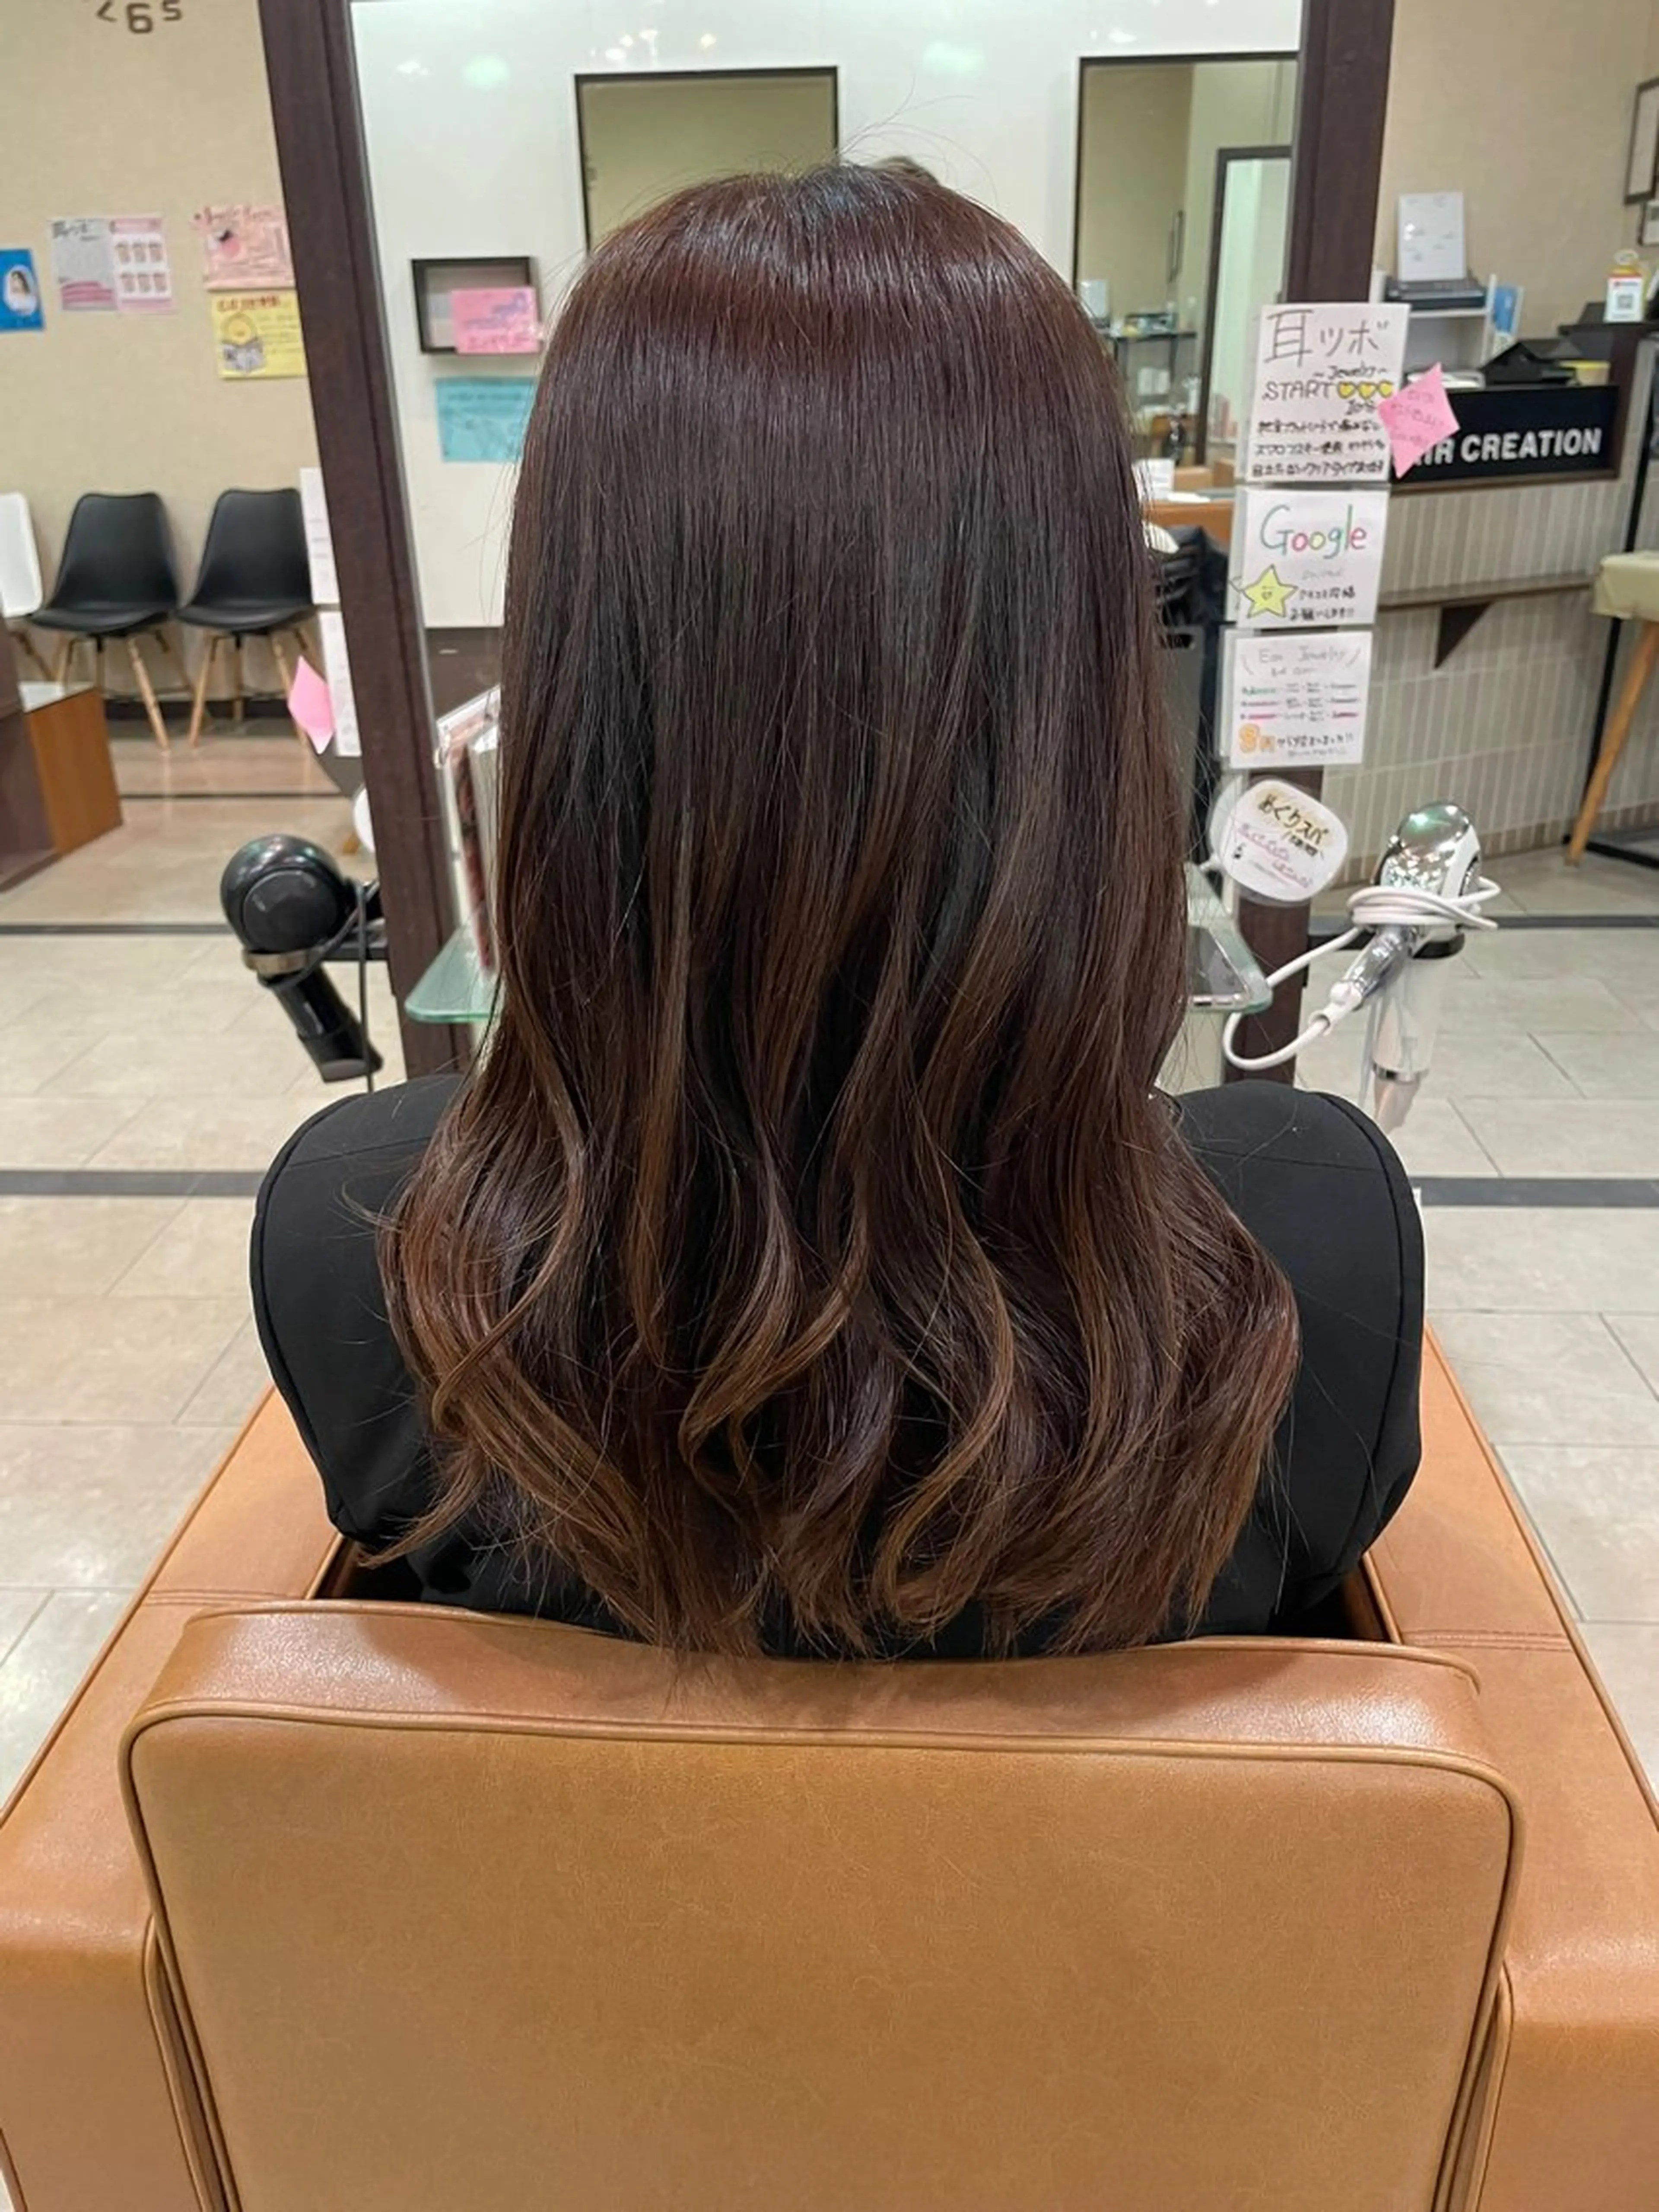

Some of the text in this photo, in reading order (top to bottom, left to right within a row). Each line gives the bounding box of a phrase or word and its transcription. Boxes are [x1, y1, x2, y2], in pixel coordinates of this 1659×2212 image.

[1264, 309, 1389, 368] 耳ツボ
[1262, 379, 1334, 401] START
[1460, 428, 1602, 463] CREATION
[1260, 504, 1367, 559] Google
